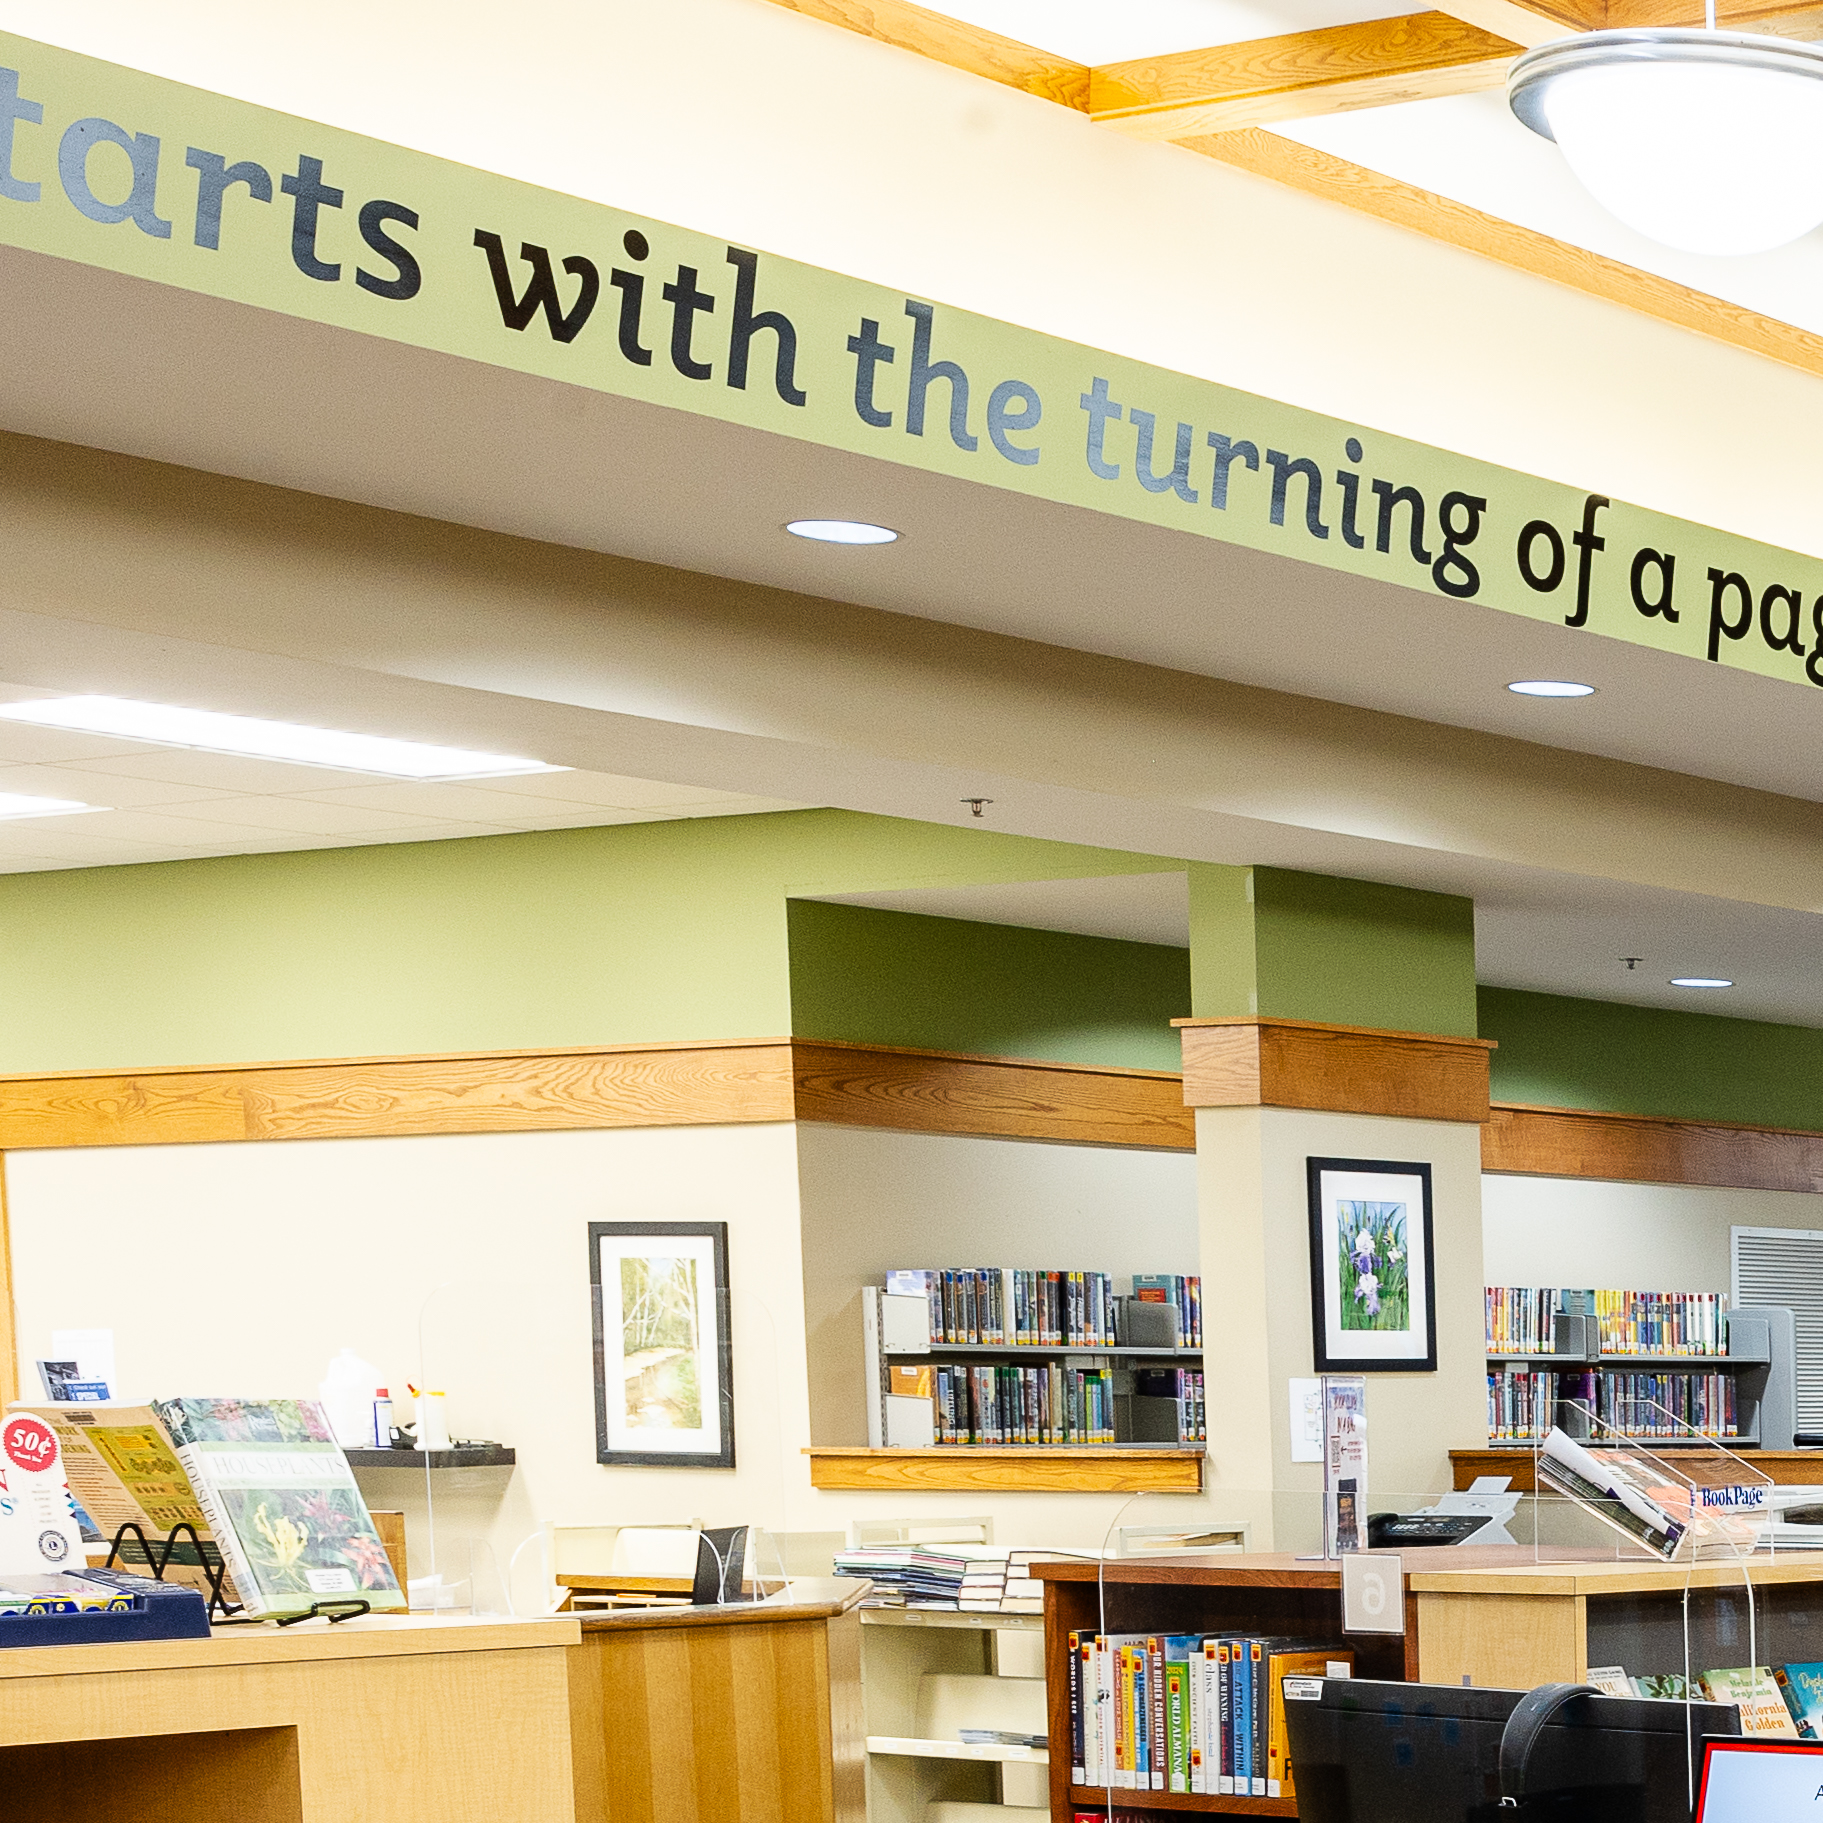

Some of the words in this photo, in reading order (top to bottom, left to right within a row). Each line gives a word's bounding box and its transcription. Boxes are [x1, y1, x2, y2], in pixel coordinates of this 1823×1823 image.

[473, 229, 806, 408] with
[847, 298, 1042, 466] the
[1080, 376, 1486, 599] turning
[1516, 494, 1611, 628] of
[1630, 547, 1680, 625] a
[10, 1428, 51, 1459] 50¢
[213, 1457, 347, 1475] HOUSEPLANTS
[180, 1453, 237, 1569] HOUSEPLANTS
[1205, 1663, 1216, 1694] class
[1730, 1686, 1772, 1697] Benjamin
[1234, 1681, 1244, 1720] ATTACK
[1745, 1717, 1784, 1730] Golden
[1235, 1733, 1245, 1771] WITHIN
